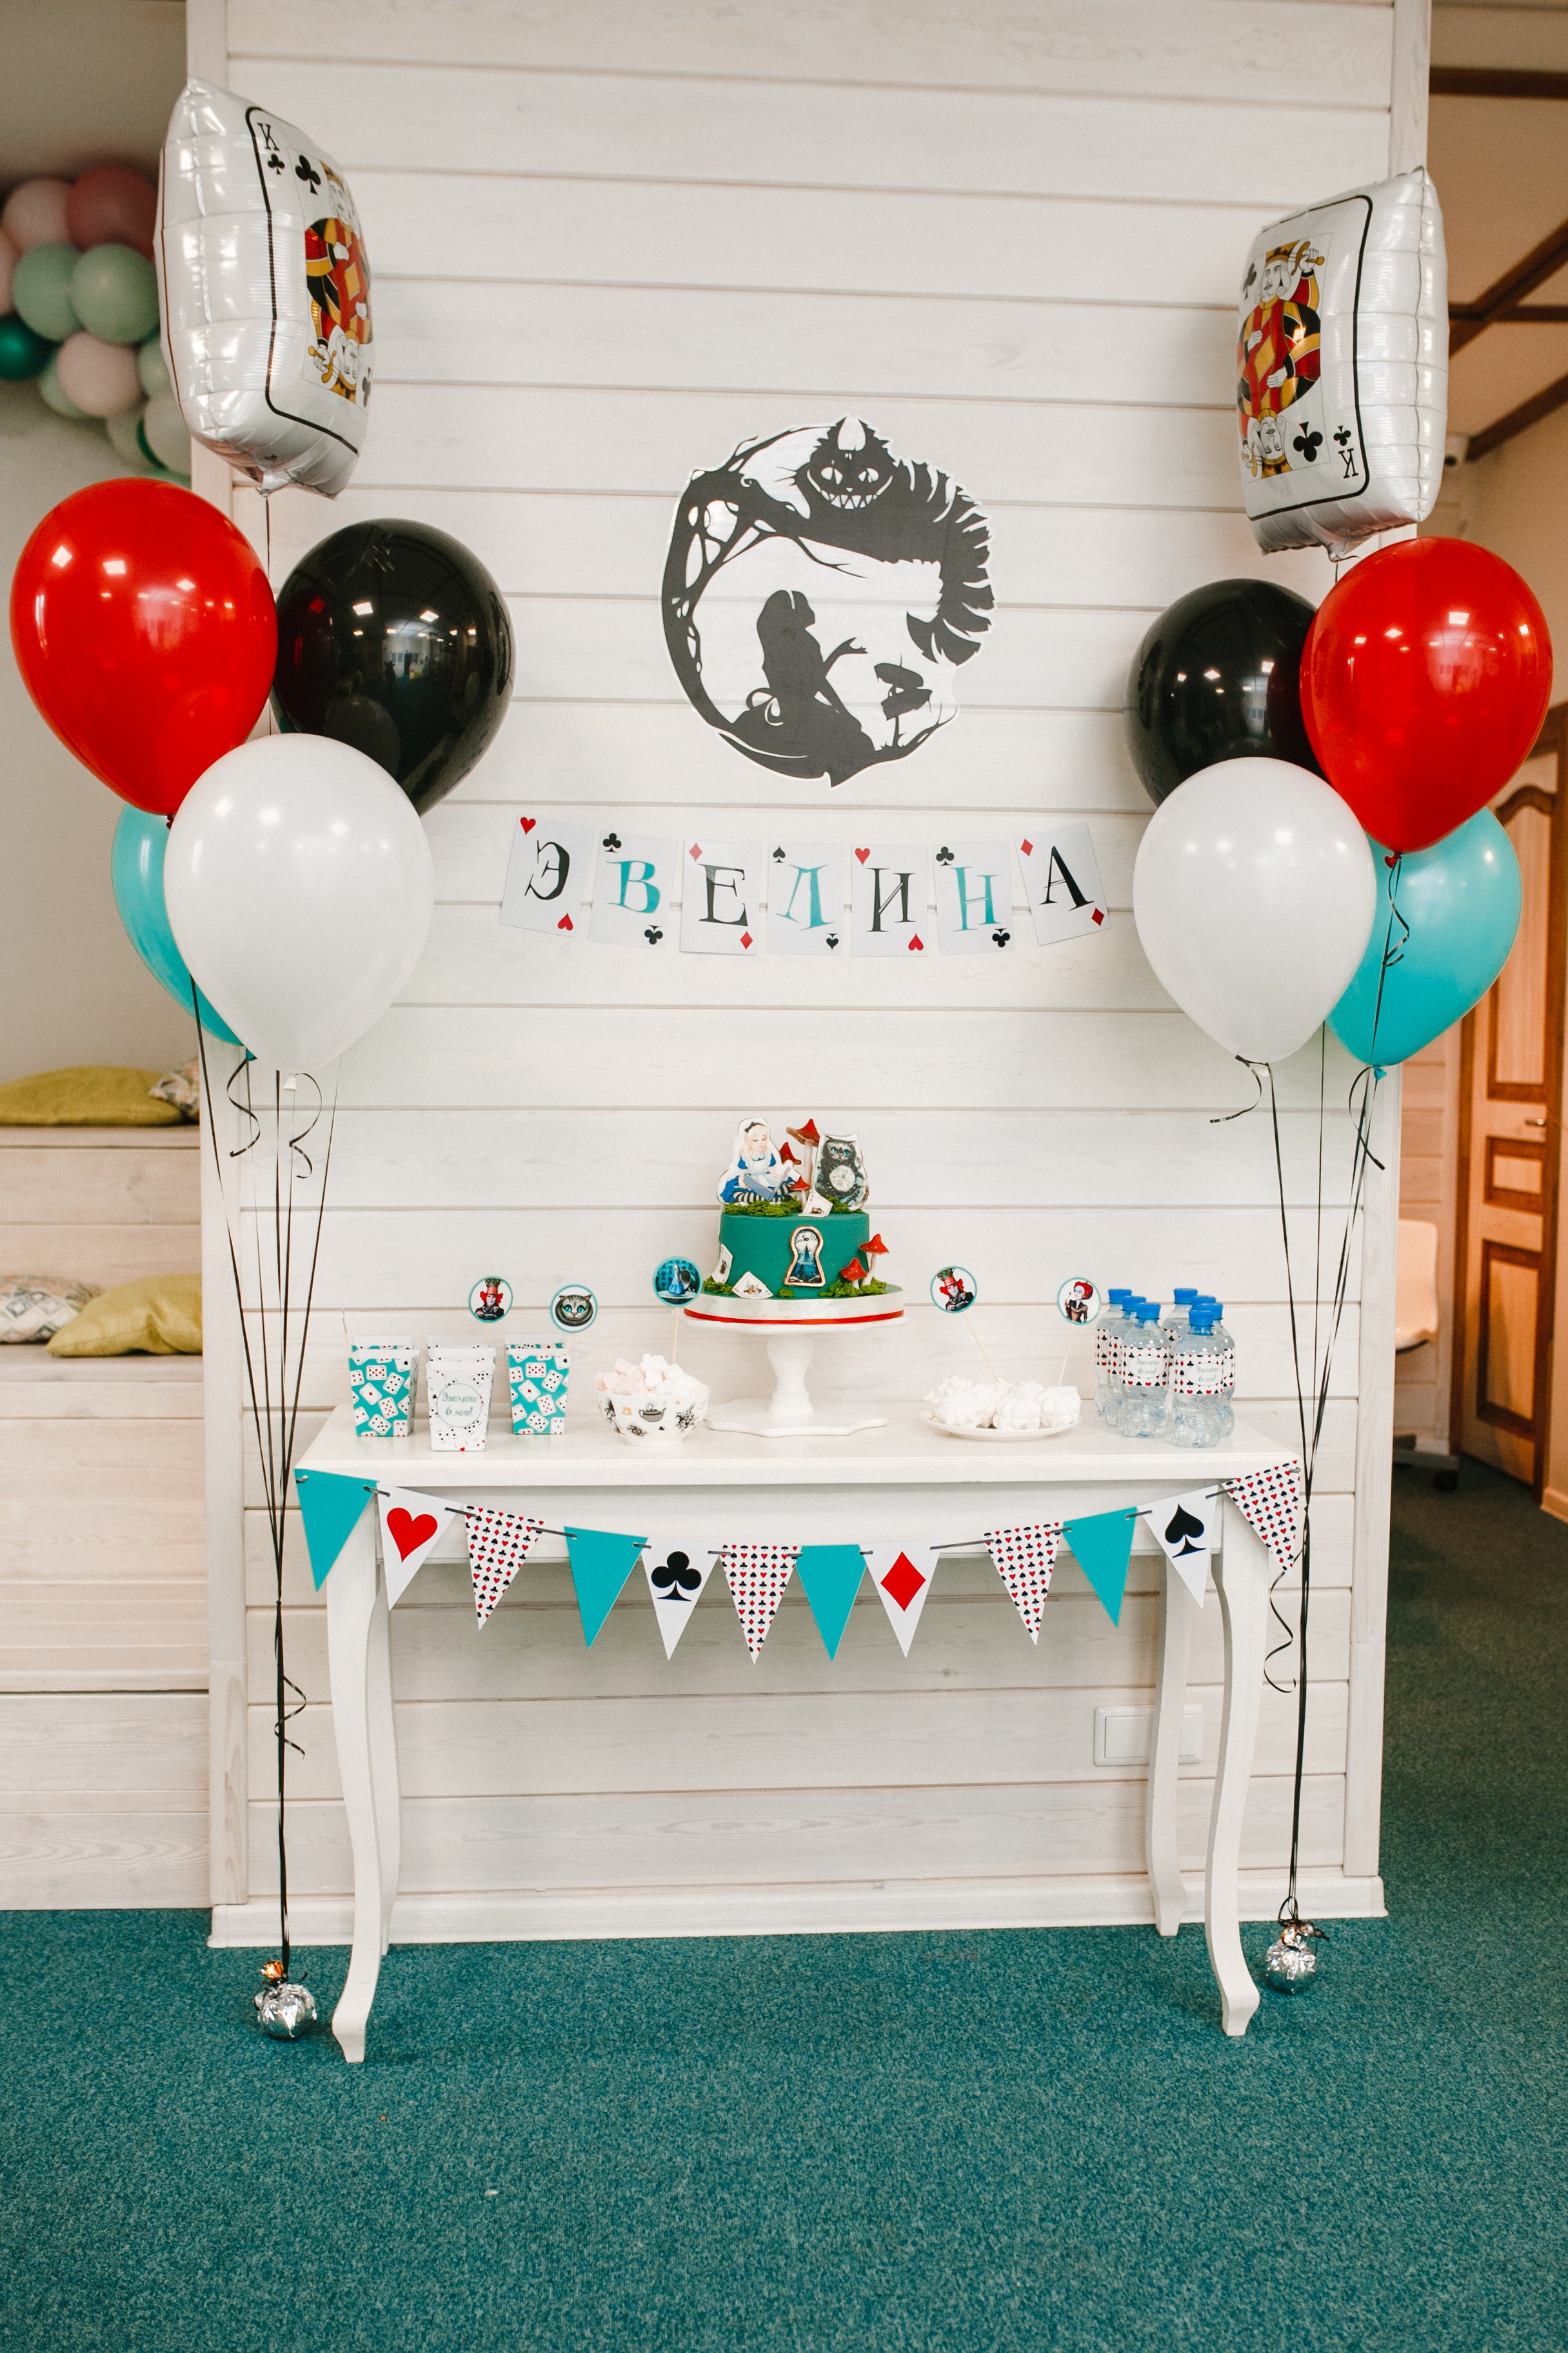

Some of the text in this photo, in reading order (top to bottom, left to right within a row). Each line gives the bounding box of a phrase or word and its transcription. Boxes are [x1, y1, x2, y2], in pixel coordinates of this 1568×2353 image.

[257, 122, 280, 152] K
[1338, 448, 1359, 479] K
[442, 1392, 477, 1403] Эвелине
[445, 1405, 473, 1416] 6 лет!
